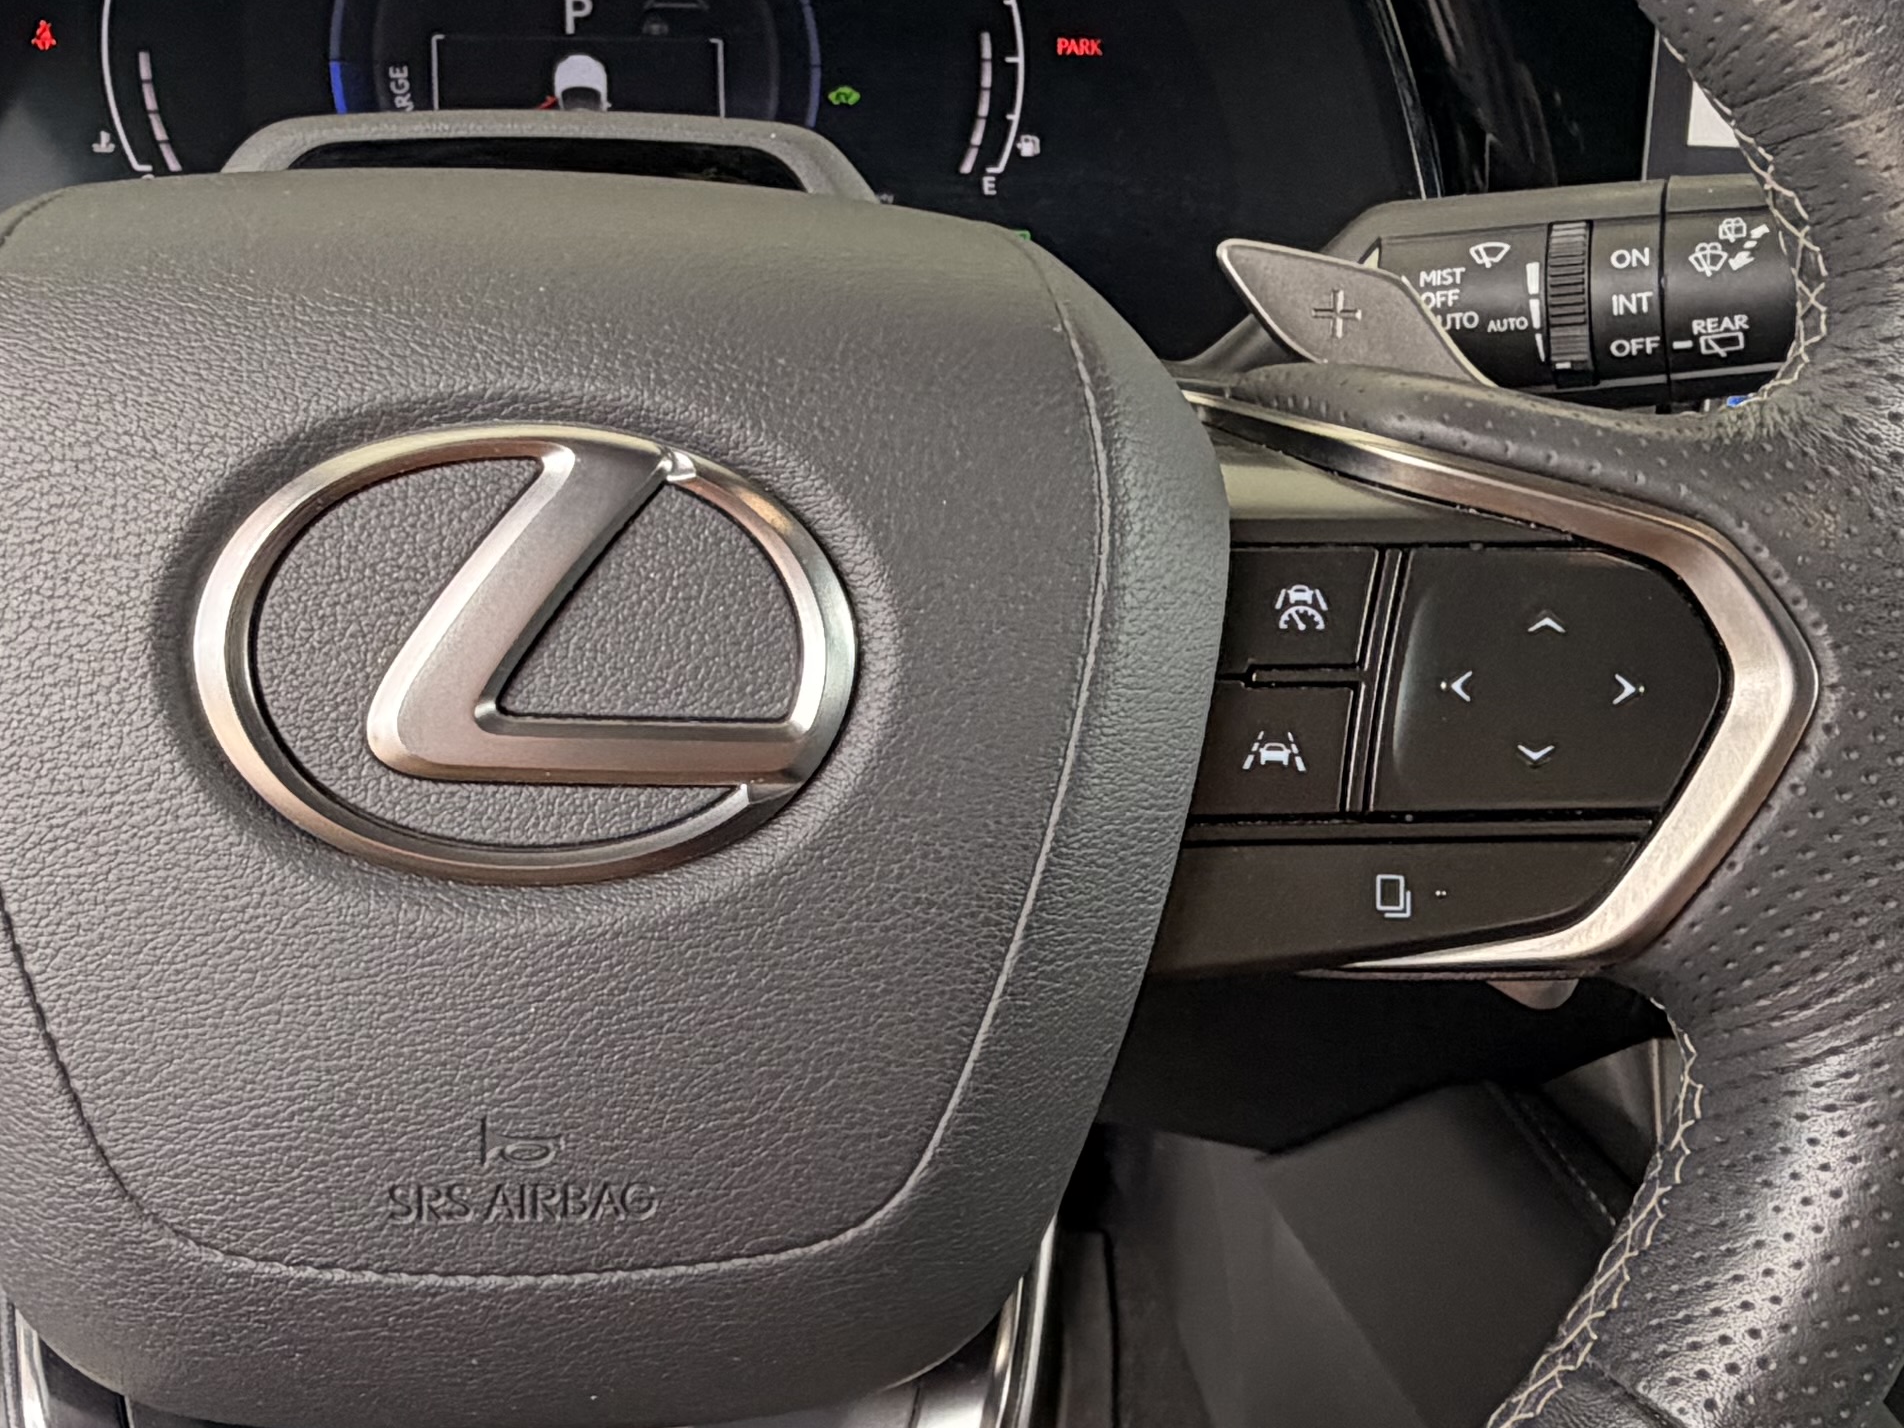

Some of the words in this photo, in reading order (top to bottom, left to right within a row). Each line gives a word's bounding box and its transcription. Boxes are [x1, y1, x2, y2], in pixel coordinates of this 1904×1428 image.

[1056, 36, 1104, 56] PARK
[982, 175, 998, 196] E
[1609, 245, 1652, 270] ON
[1419, 266, 1467, 288] MIST
[1421, 288, 1461, 309] OFF
[1610, 291, 1654, 317] INT
[1436, 310, 1480, 332] UTO
[1486, 316, 1530, 333] AUTO
[1691, 313, 1749, 336] REAR
[1609, 336, 1661, 358] OFF
[388, 1182, 472, 1224] SRS
[484, 1182, 660, 1224] AIRBAG
